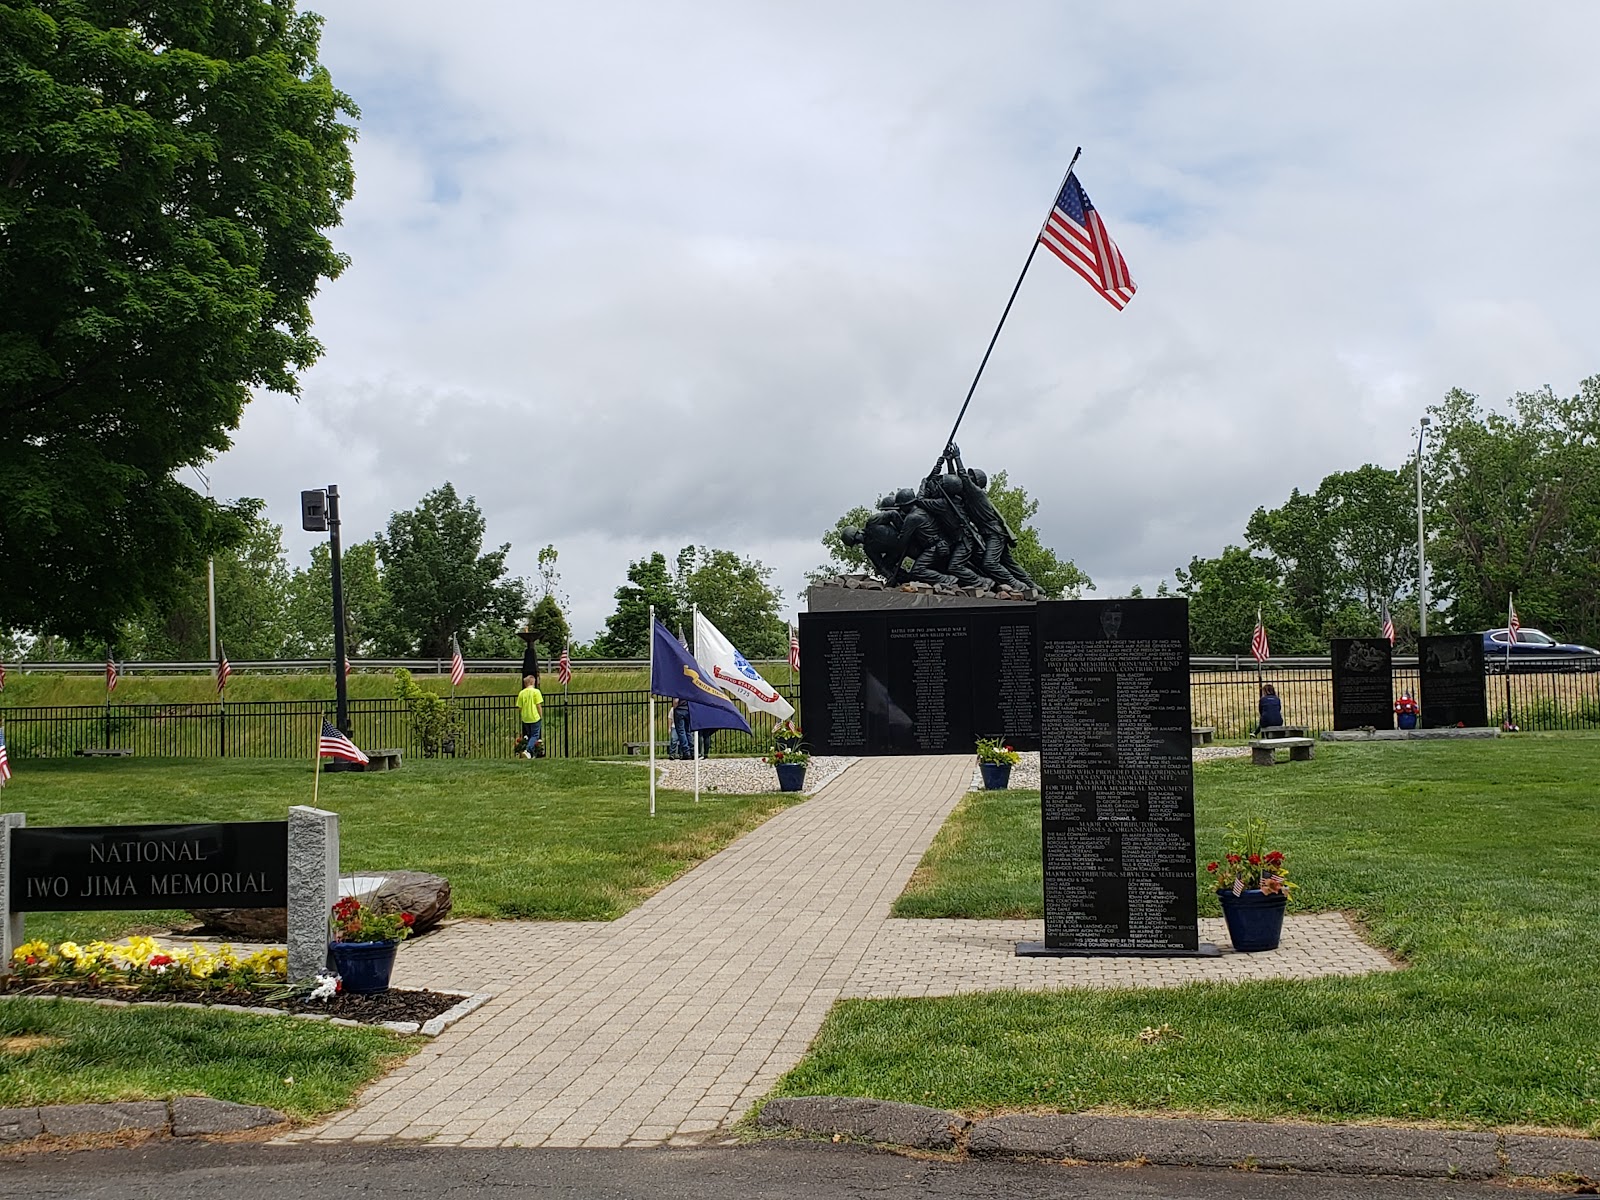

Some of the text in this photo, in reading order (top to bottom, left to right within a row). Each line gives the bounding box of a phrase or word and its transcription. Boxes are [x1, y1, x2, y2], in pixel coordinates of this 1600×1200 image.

[696, 680, 710, 692] UNITED
[718, 674, 772, 702] UNITED STATES ARMY
[737, 686, 750, 698] 1775
[90, 840, 207, 864] NATIONAL
[27, 872, 273, 898] IWO JIMA MEMORIAL
